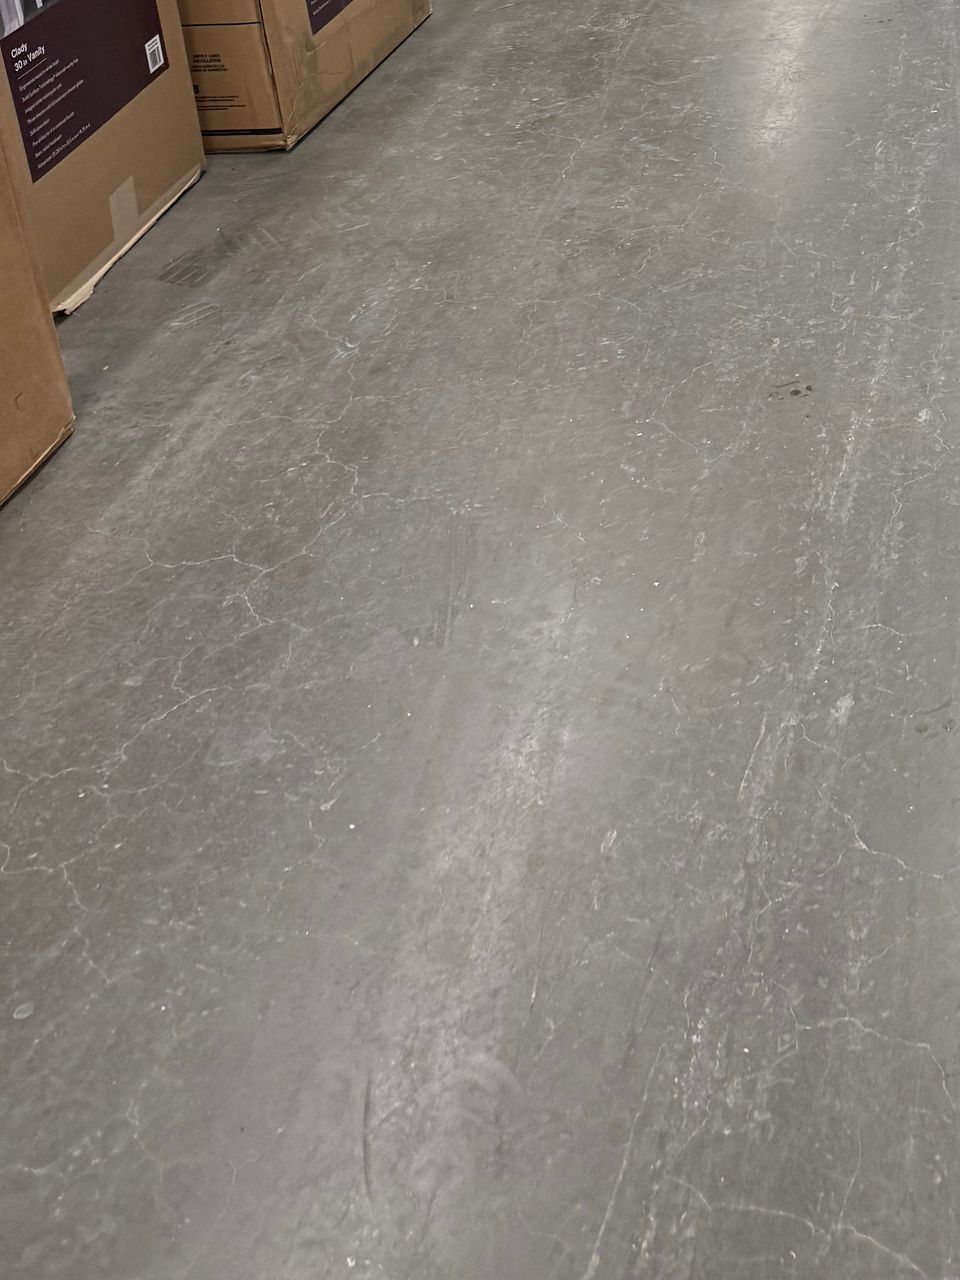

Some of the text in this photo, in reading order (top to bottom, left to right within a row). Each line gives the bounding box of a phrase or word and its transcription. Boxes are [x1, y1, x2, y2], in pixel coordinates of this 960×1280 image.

[11, 42, 28, 58] Clady
[14, 60, 23, 72] 30
[27, 45, 45, 62] Vanity
